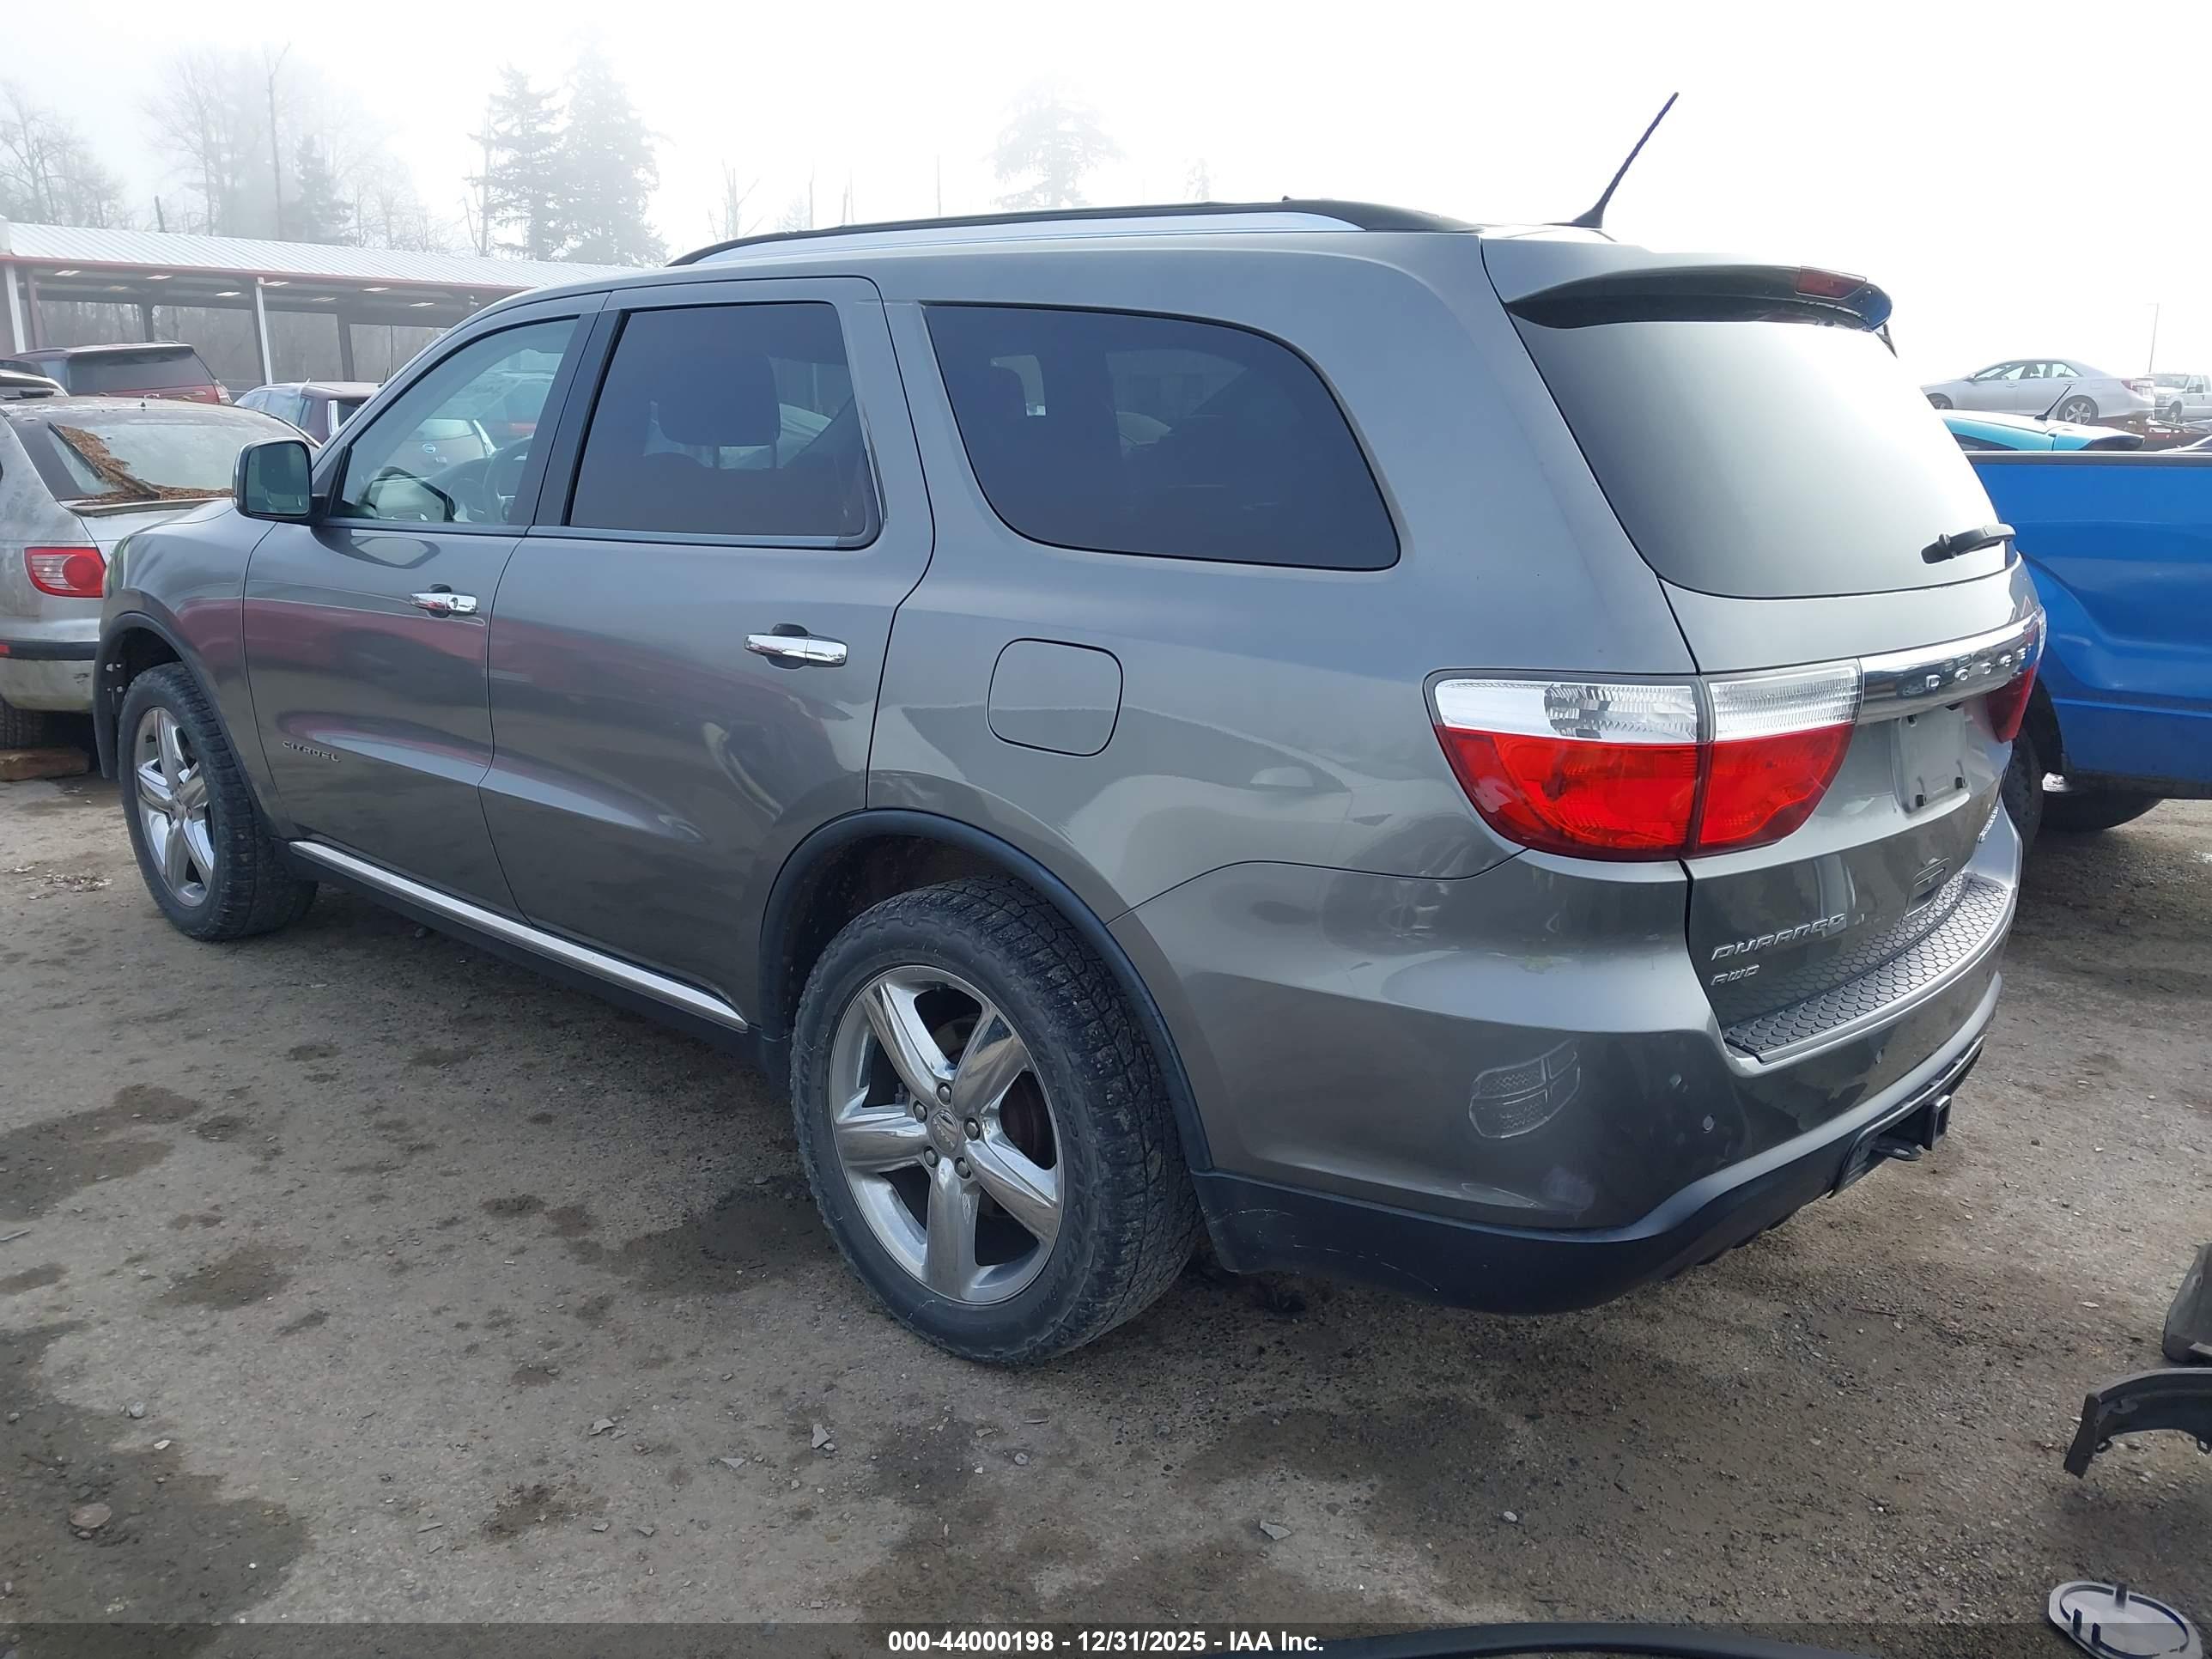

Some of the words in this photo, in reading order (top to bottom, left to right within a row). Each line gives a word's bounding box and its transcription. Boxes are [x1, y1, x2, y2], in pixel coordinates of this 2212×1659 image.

[1925, 646, 2027, 689] DODGE
[282, 740, 342, 763] CITADEL
[1711, 913, 1846, 961] DURANGO
[1711, 963, 1760, 986] AWD
